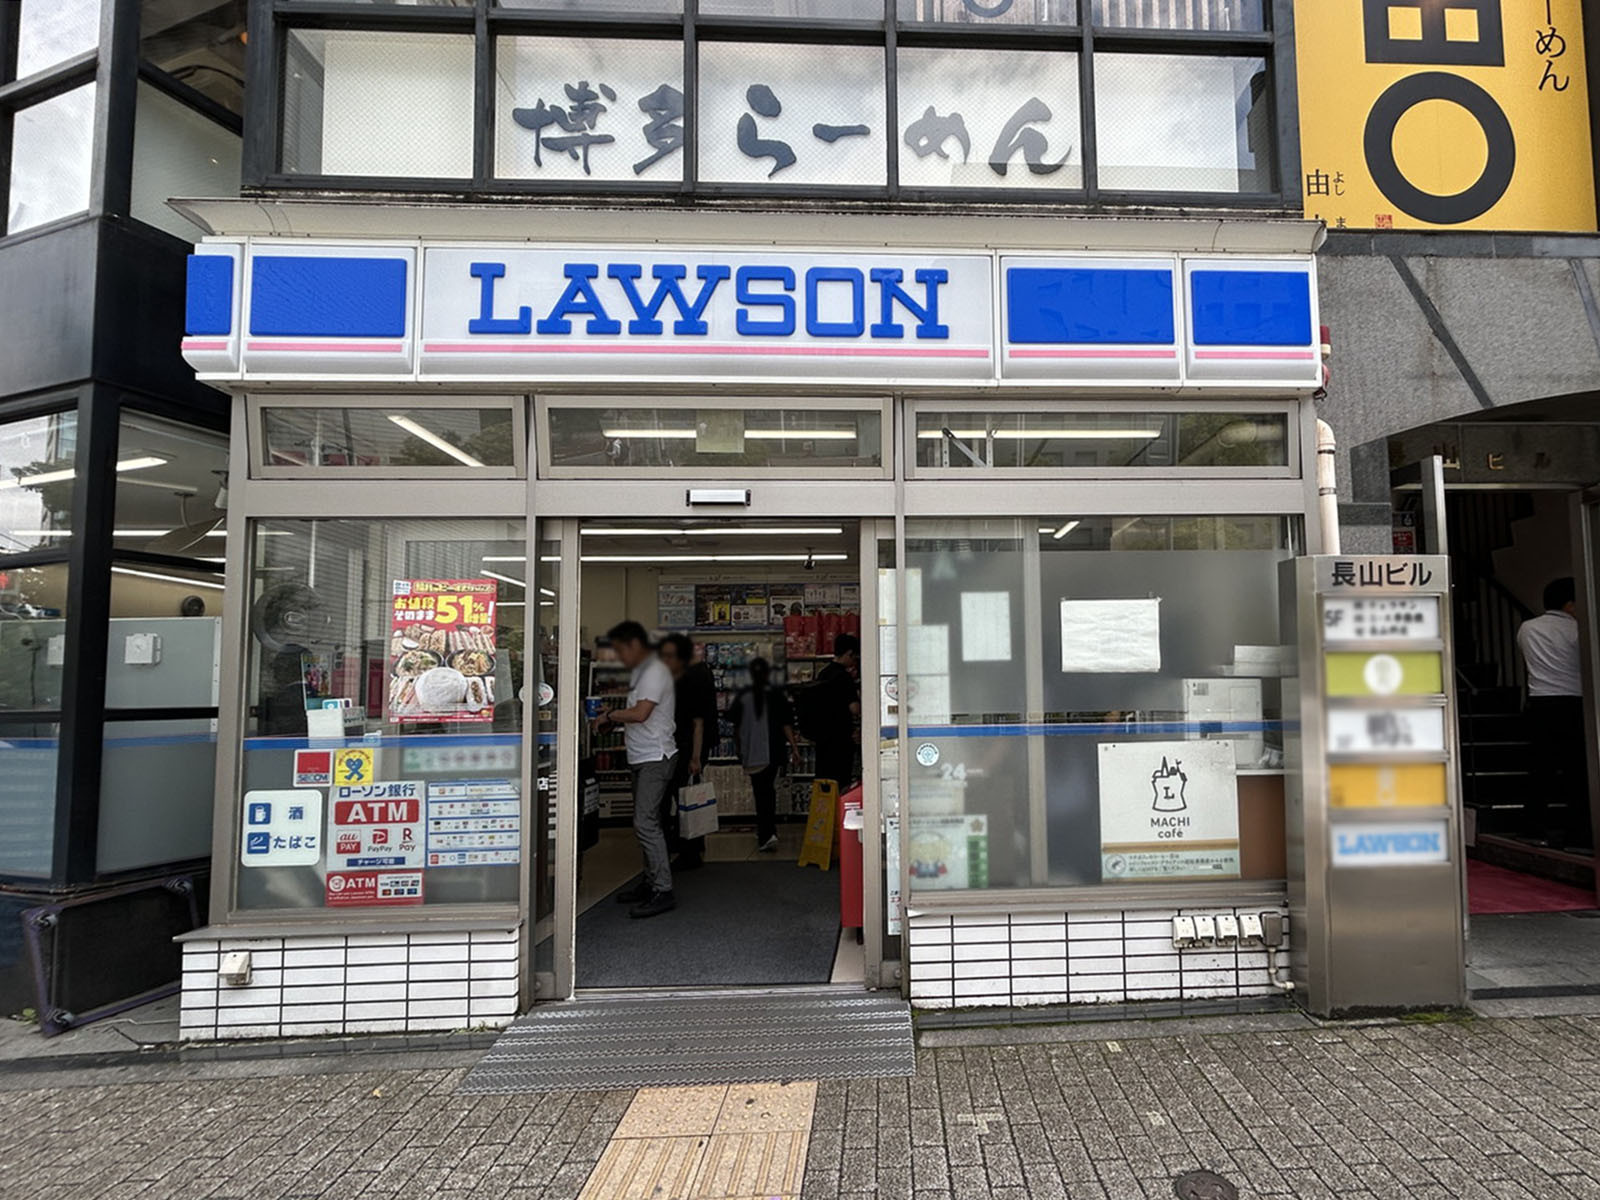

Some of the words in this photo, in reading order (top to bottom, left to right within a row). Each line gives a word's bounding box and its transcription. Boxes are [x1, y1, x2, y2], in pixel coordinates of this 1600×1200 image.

[512, 81, 1072, 178] 博多らーめん
[468, 262, 950, 339] LAWSON
[1331, 561, 1432, 587] 長山ビル
[394, 610, 435, 621] そのまま
[339, 784, 416, 798] ローソン銀行
[288, 806, 304, 820] 酒
[346, 802, 408, 823] ATM
[1150, 816, 1190, 828] MACHI
[1157, 828, 1184, 839] café
[273, 835, 316, 849] たばこ
[340, 843, 357, 851] PAY
[398, 844, 416, 852] Pay
[346, 876, 376, 889] ATM
